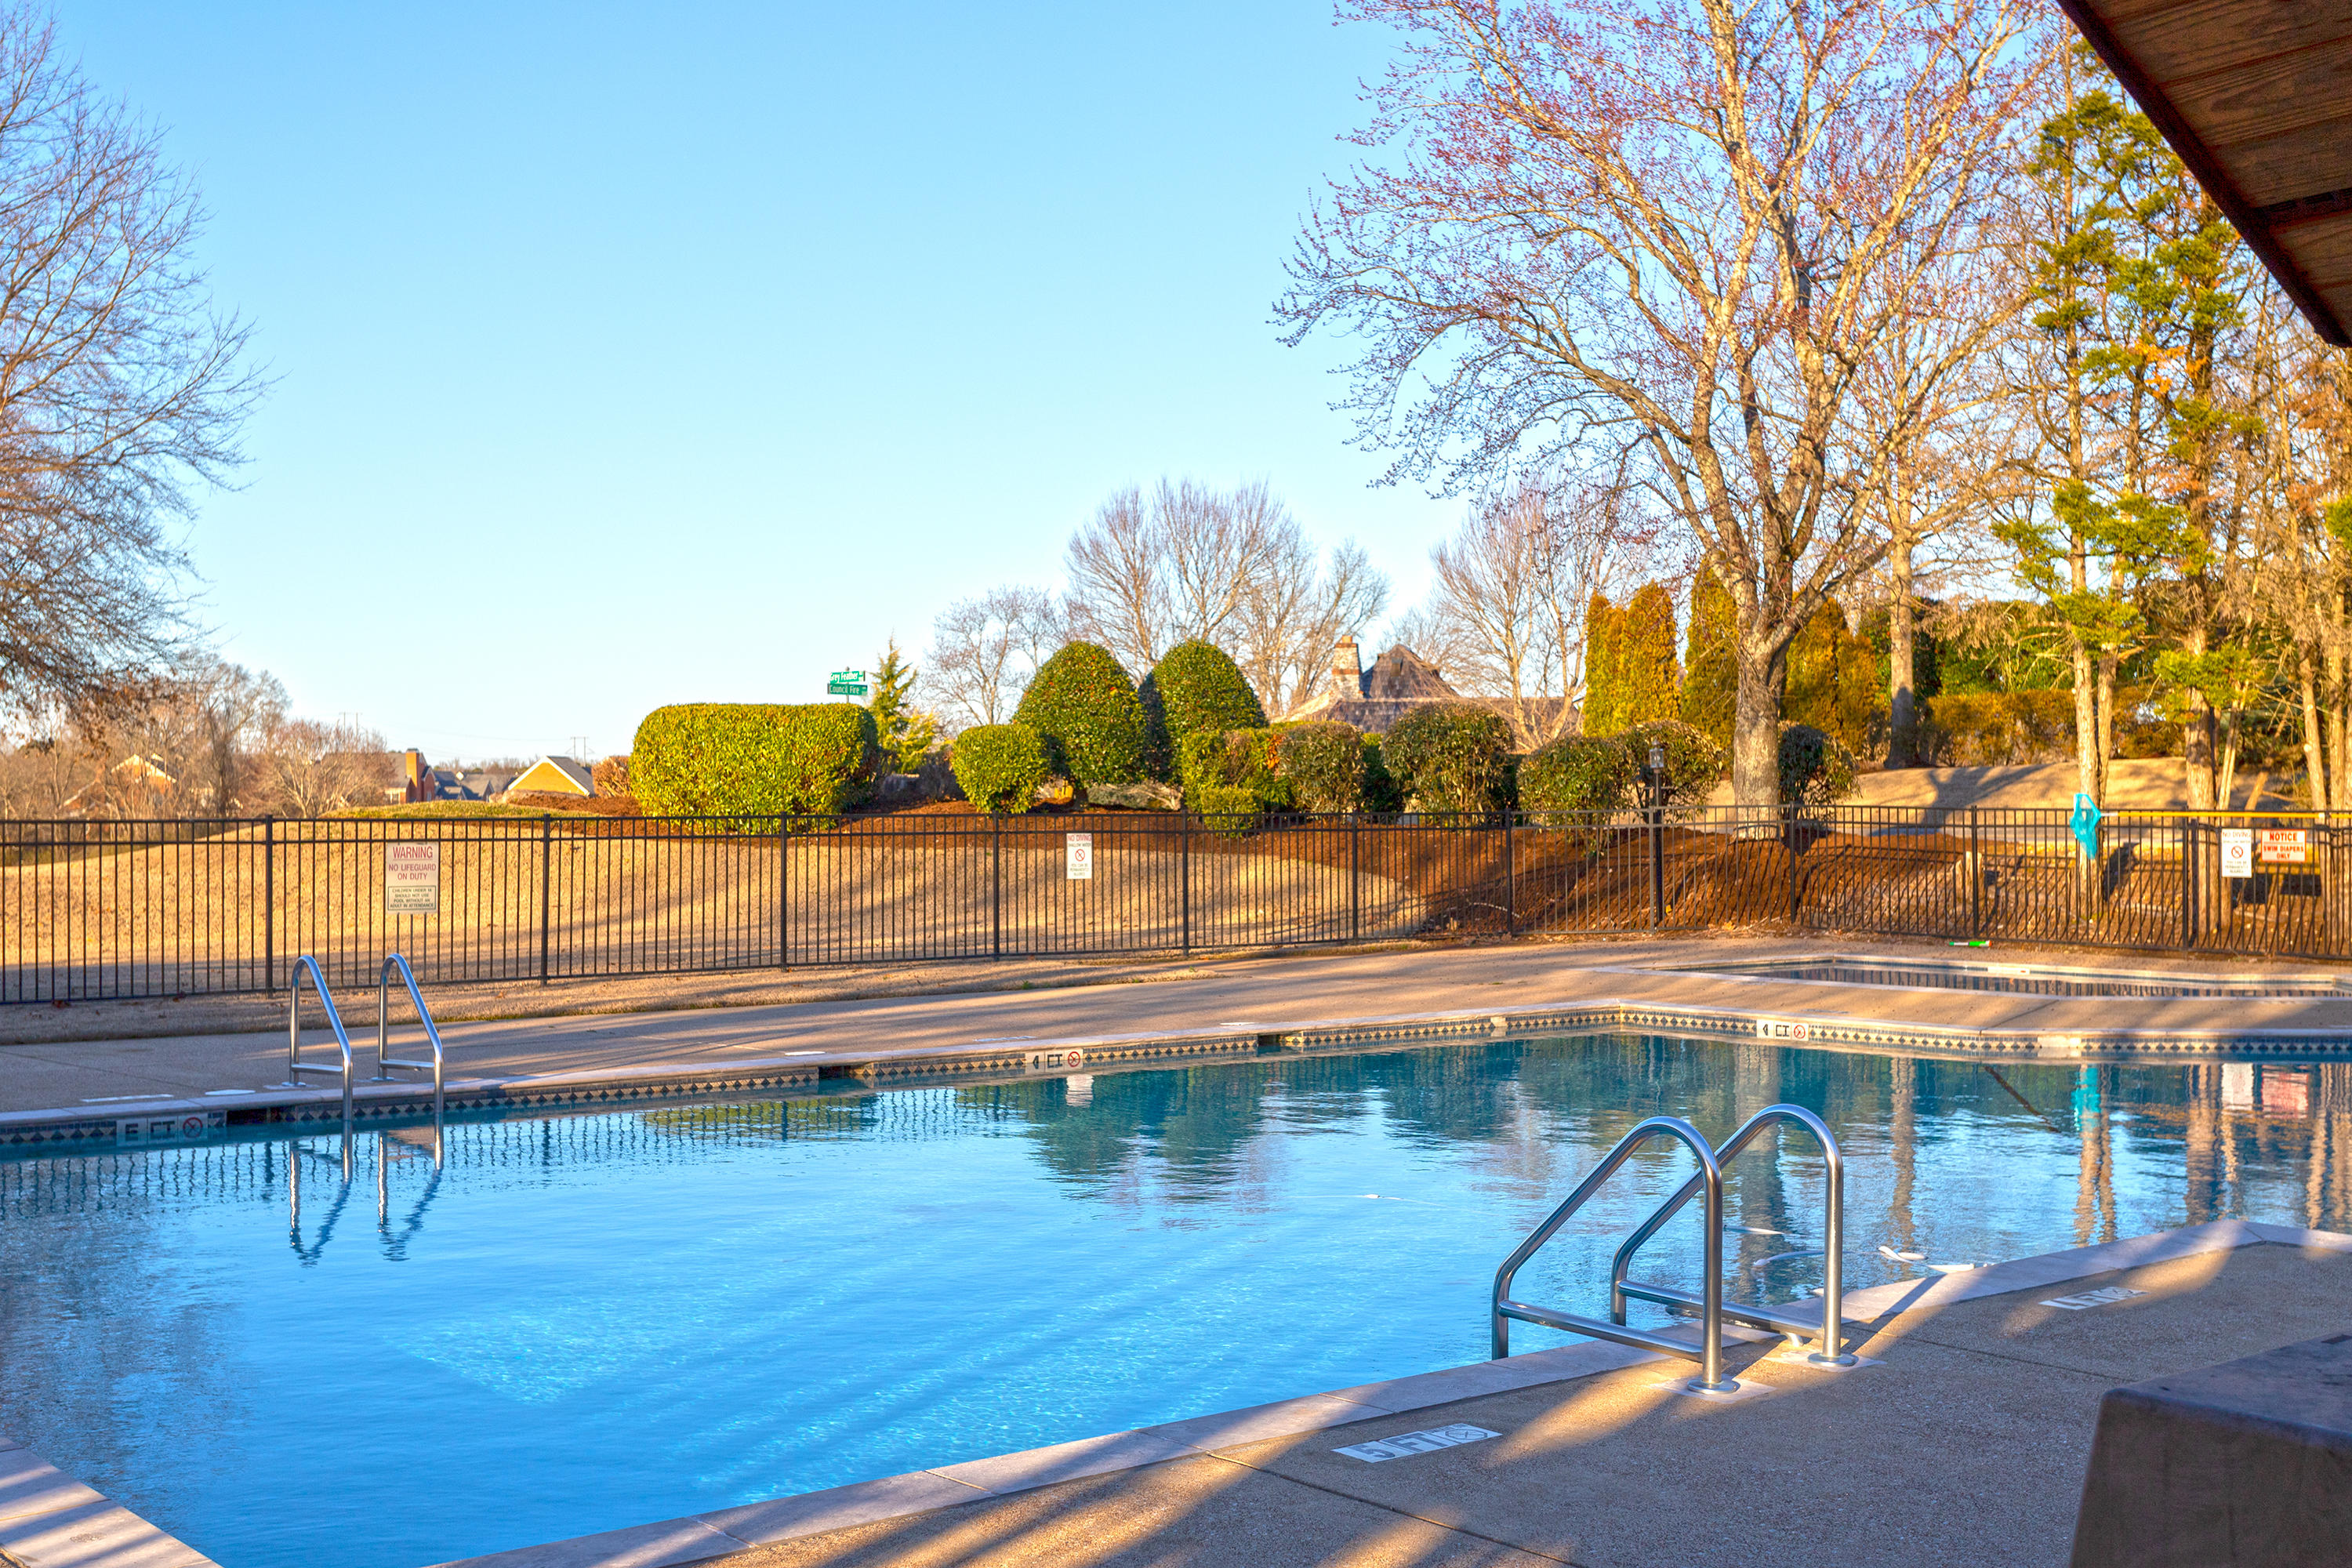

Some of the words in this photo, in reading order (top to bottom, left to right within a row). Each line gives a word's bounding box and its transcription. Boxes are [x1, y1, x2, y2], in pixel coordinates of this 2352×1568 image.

[840, 671, 859, 681] Feather
[829, 684, 848, 693] Council
[849, 685, 859, 694] Fire
[2269, 833, 2297, 841] NOTICE
[393, 846, 433, 858] WARNING
[1350, 1445, 1396, 1458] 5
[1382, 1432, 1449, 1452] FT
